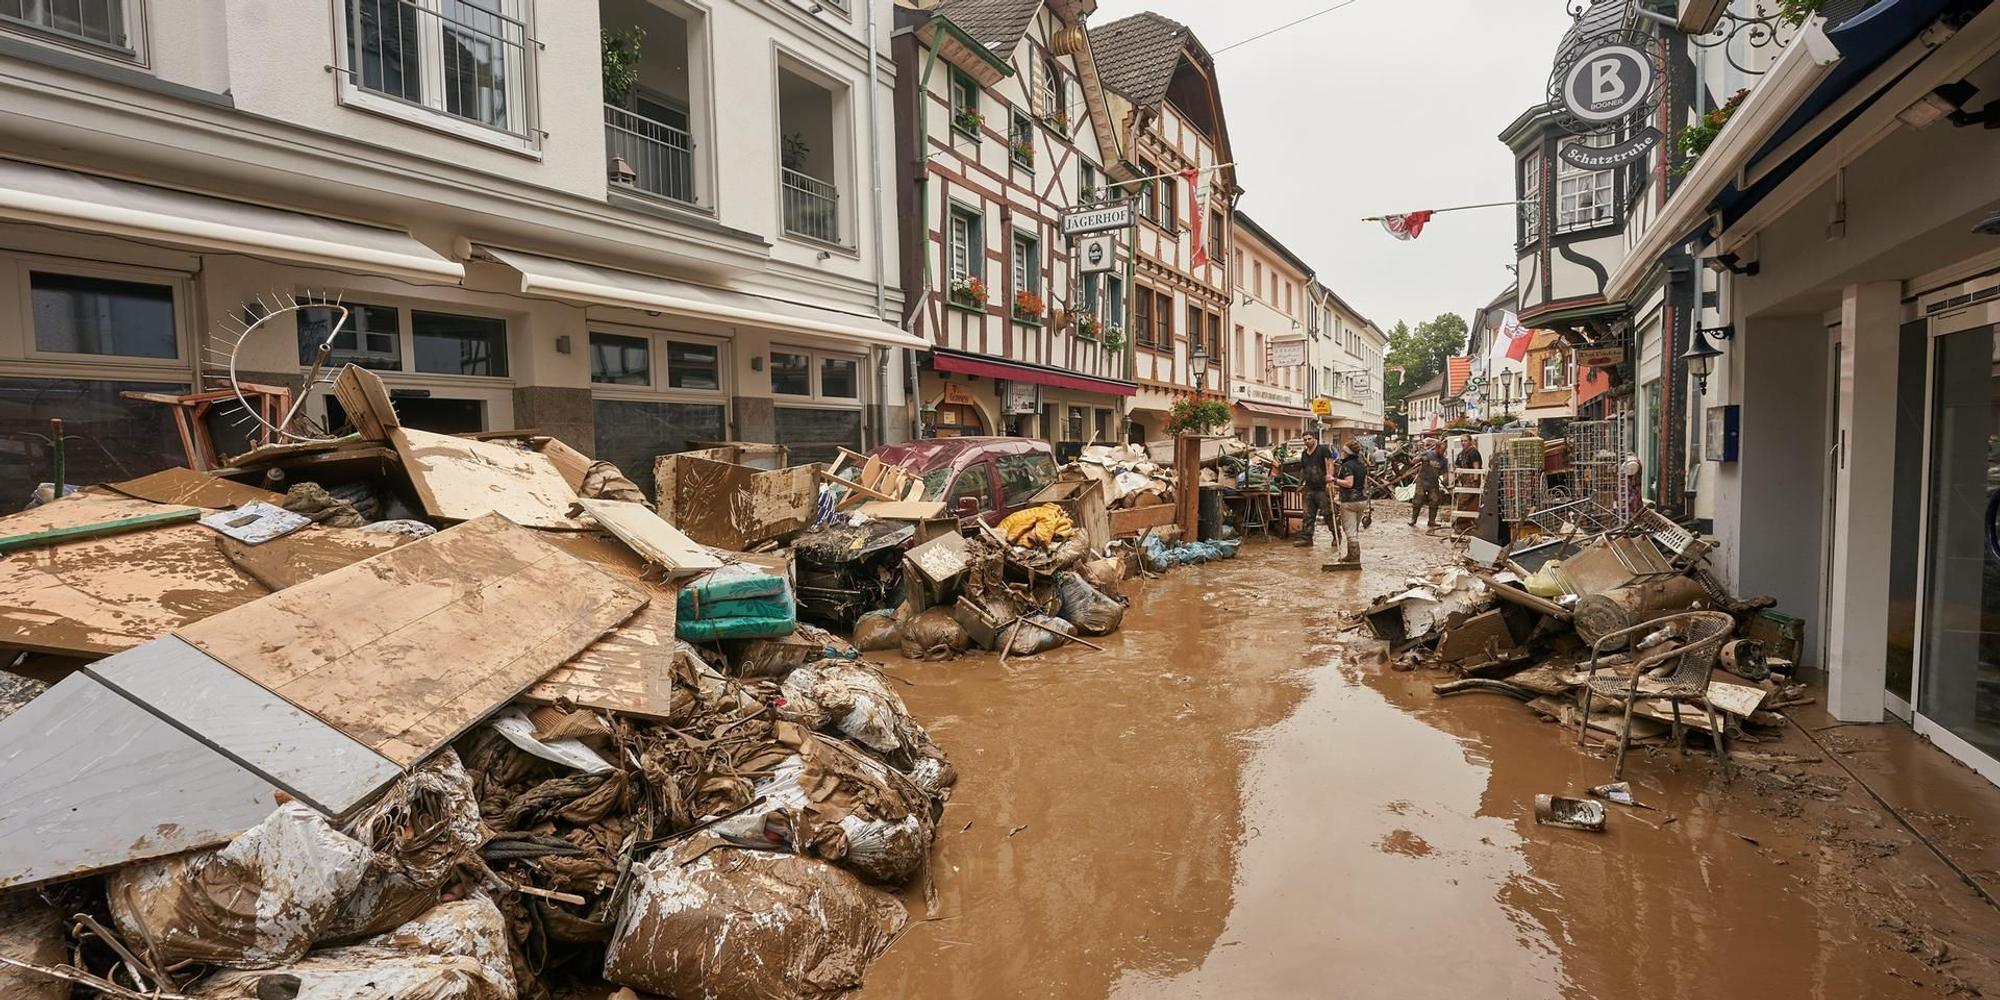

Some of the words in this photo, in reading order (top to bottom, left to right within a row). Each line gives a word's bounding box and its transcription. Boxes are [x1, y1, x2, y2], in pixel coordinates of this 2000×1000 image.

[1592, 59, 1625, 103] B
[1591, 99, 1623, 110] BOGNER
[1567, 137, 1653, 165] Schatztruhe
[1065, 209, 1128, 230] JÄGERHOF
